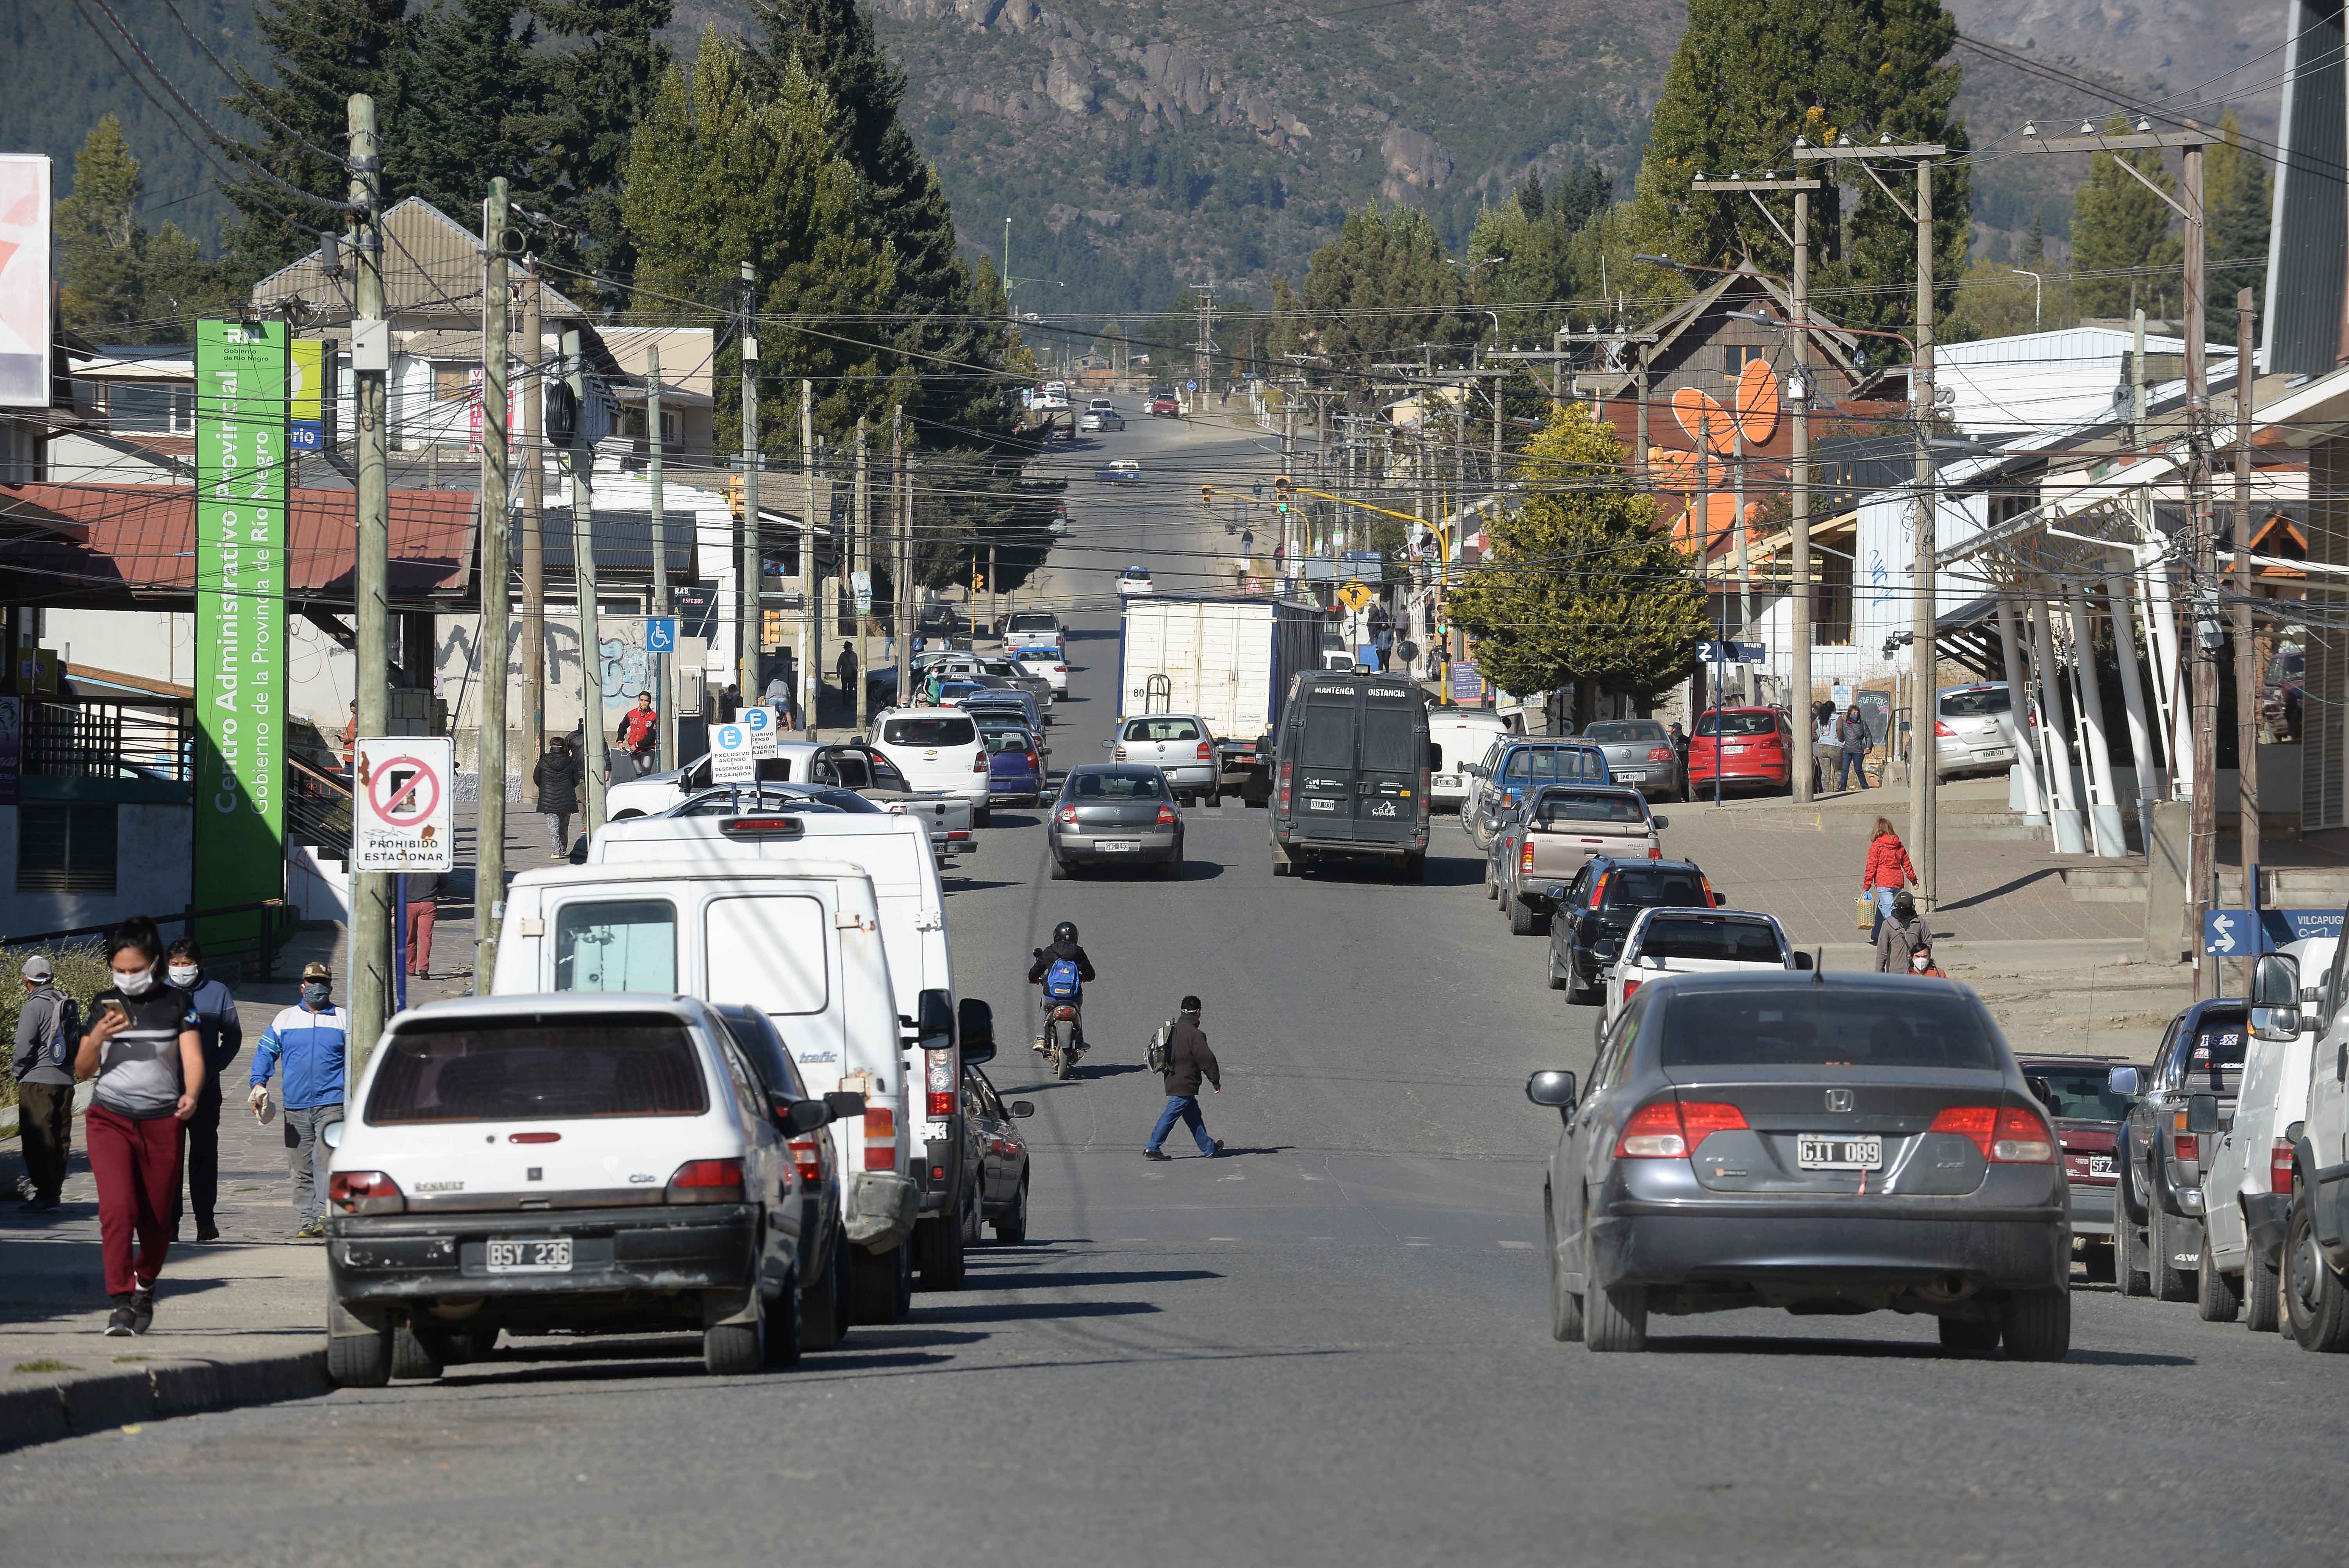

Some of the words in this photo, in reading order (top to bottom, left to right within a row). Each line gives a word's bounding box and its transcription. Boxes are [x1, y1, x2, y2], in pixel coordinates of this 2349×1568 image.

[215, 371, 237, 501] Provincial
[251, 431, 274, 499] Negro
[251, 507, 269, 542] Río
[252, 549, 269, 571] de
[216, 510, 238, 712] Administrativo
[251, 579, 269, 663] Provincia
[251, 670, 269, 684] la
[1134, 689, 1144, 697] 80
[1315, 686, 1355, 695] MANTENGA
[251, 692, 269, 715] de
[750, 712, 762, 727] E
[724, 730, 736, 746] E
[215, 718, 238, 814] Centro
[250, 722, 269, 815] Gobierno
[1801, 1142, 1834, 1162] GIT
[1845, 1143, 1879, 1162] 089
[2092, 1160, 2113, 1172] SFZ
[415, 1181, 464, 1192] RENAULT
[490, 1244, 524, 1265] BSY
[535, 1244, 569, 1265] 236
